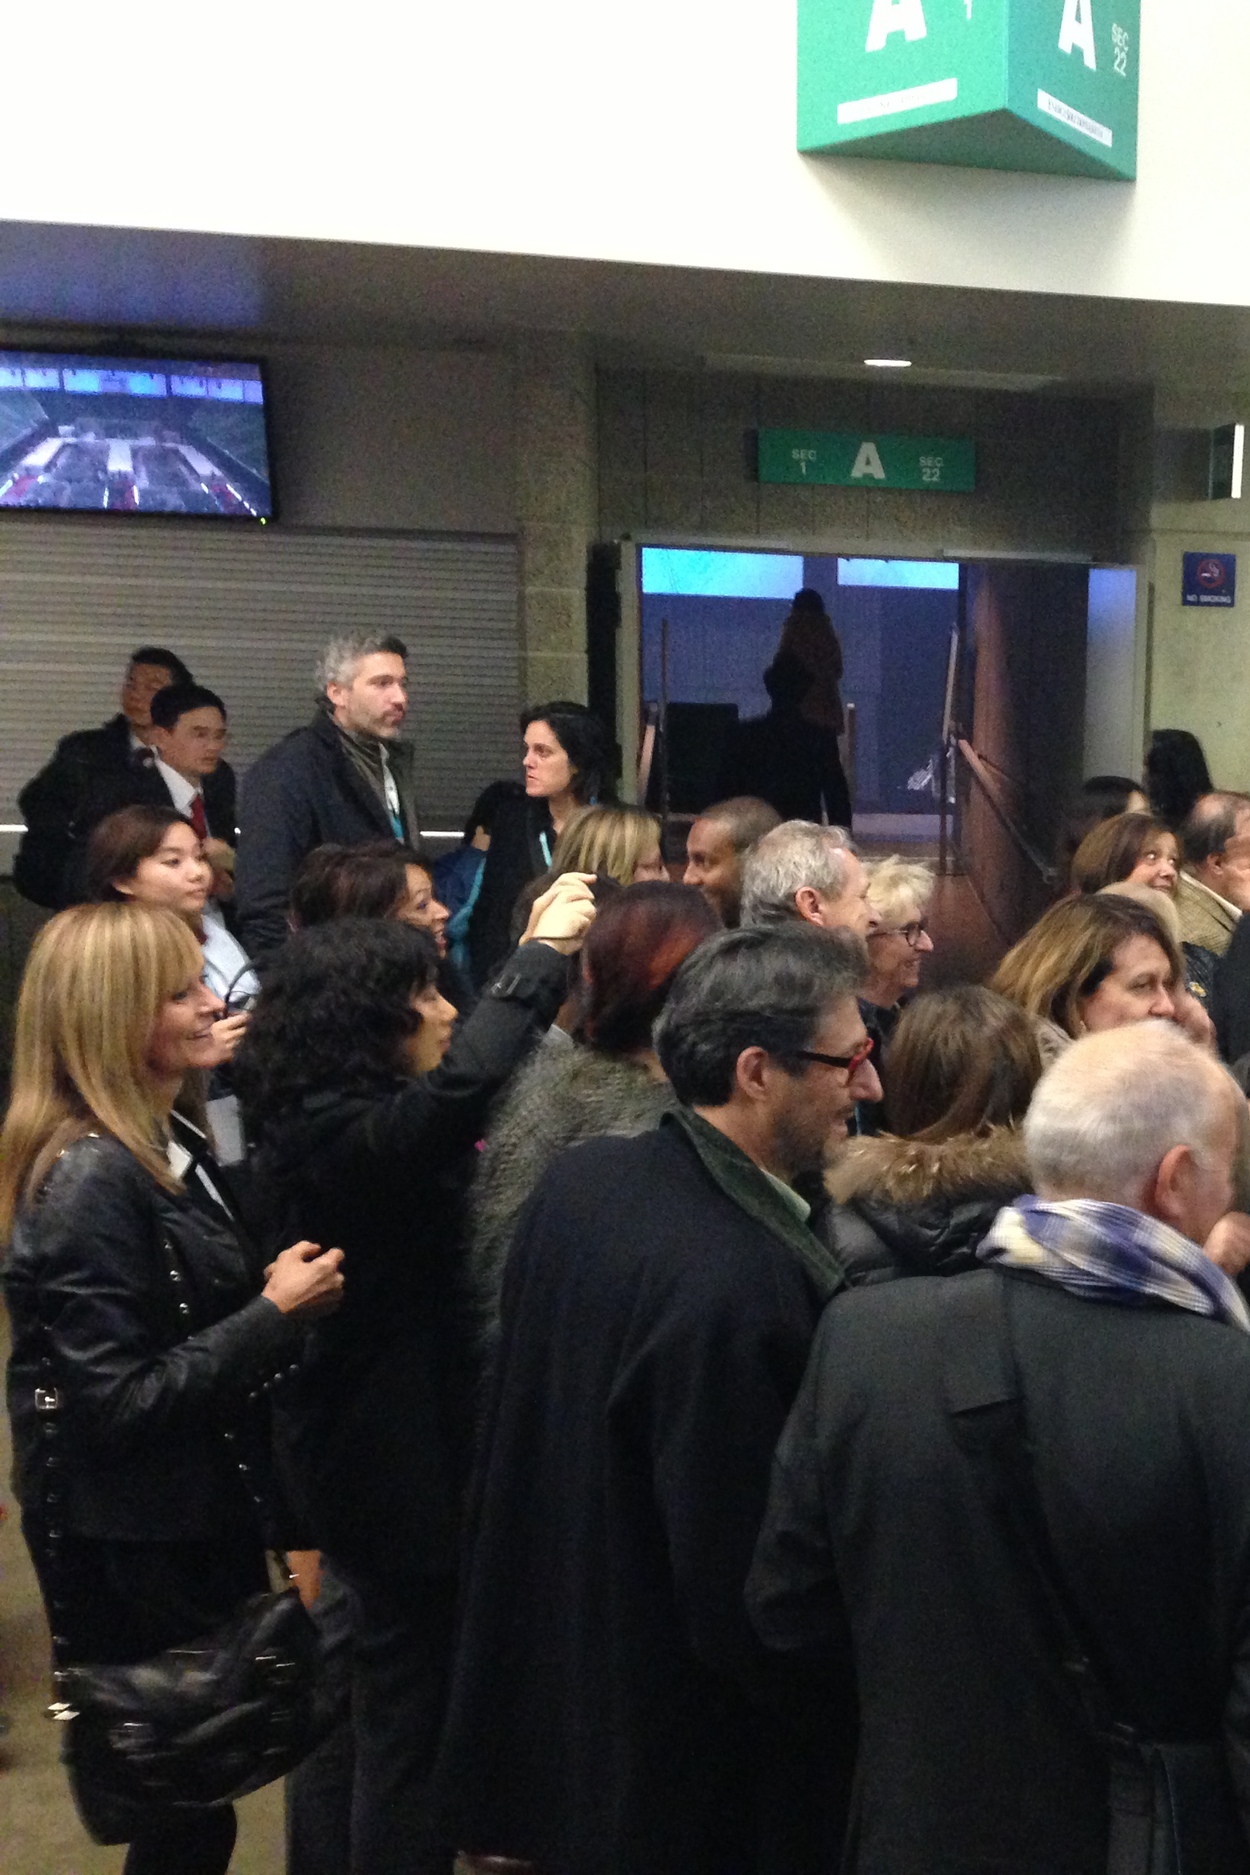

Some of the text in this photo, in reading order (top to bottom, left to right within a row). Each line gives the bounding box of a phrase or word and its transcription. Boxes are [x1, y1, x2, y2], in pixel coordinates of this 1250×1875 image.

[865, 0, 927, 52] A
[1058, 0, 1096, 70] A
[1114, 47, 1126, 76] 22
[799, 461, 807, 475] 1
[851, 441, 885, 479] A
[922, 468, 941, 482] 22
[1186, 594, 1231, 604] NO SMOKING
